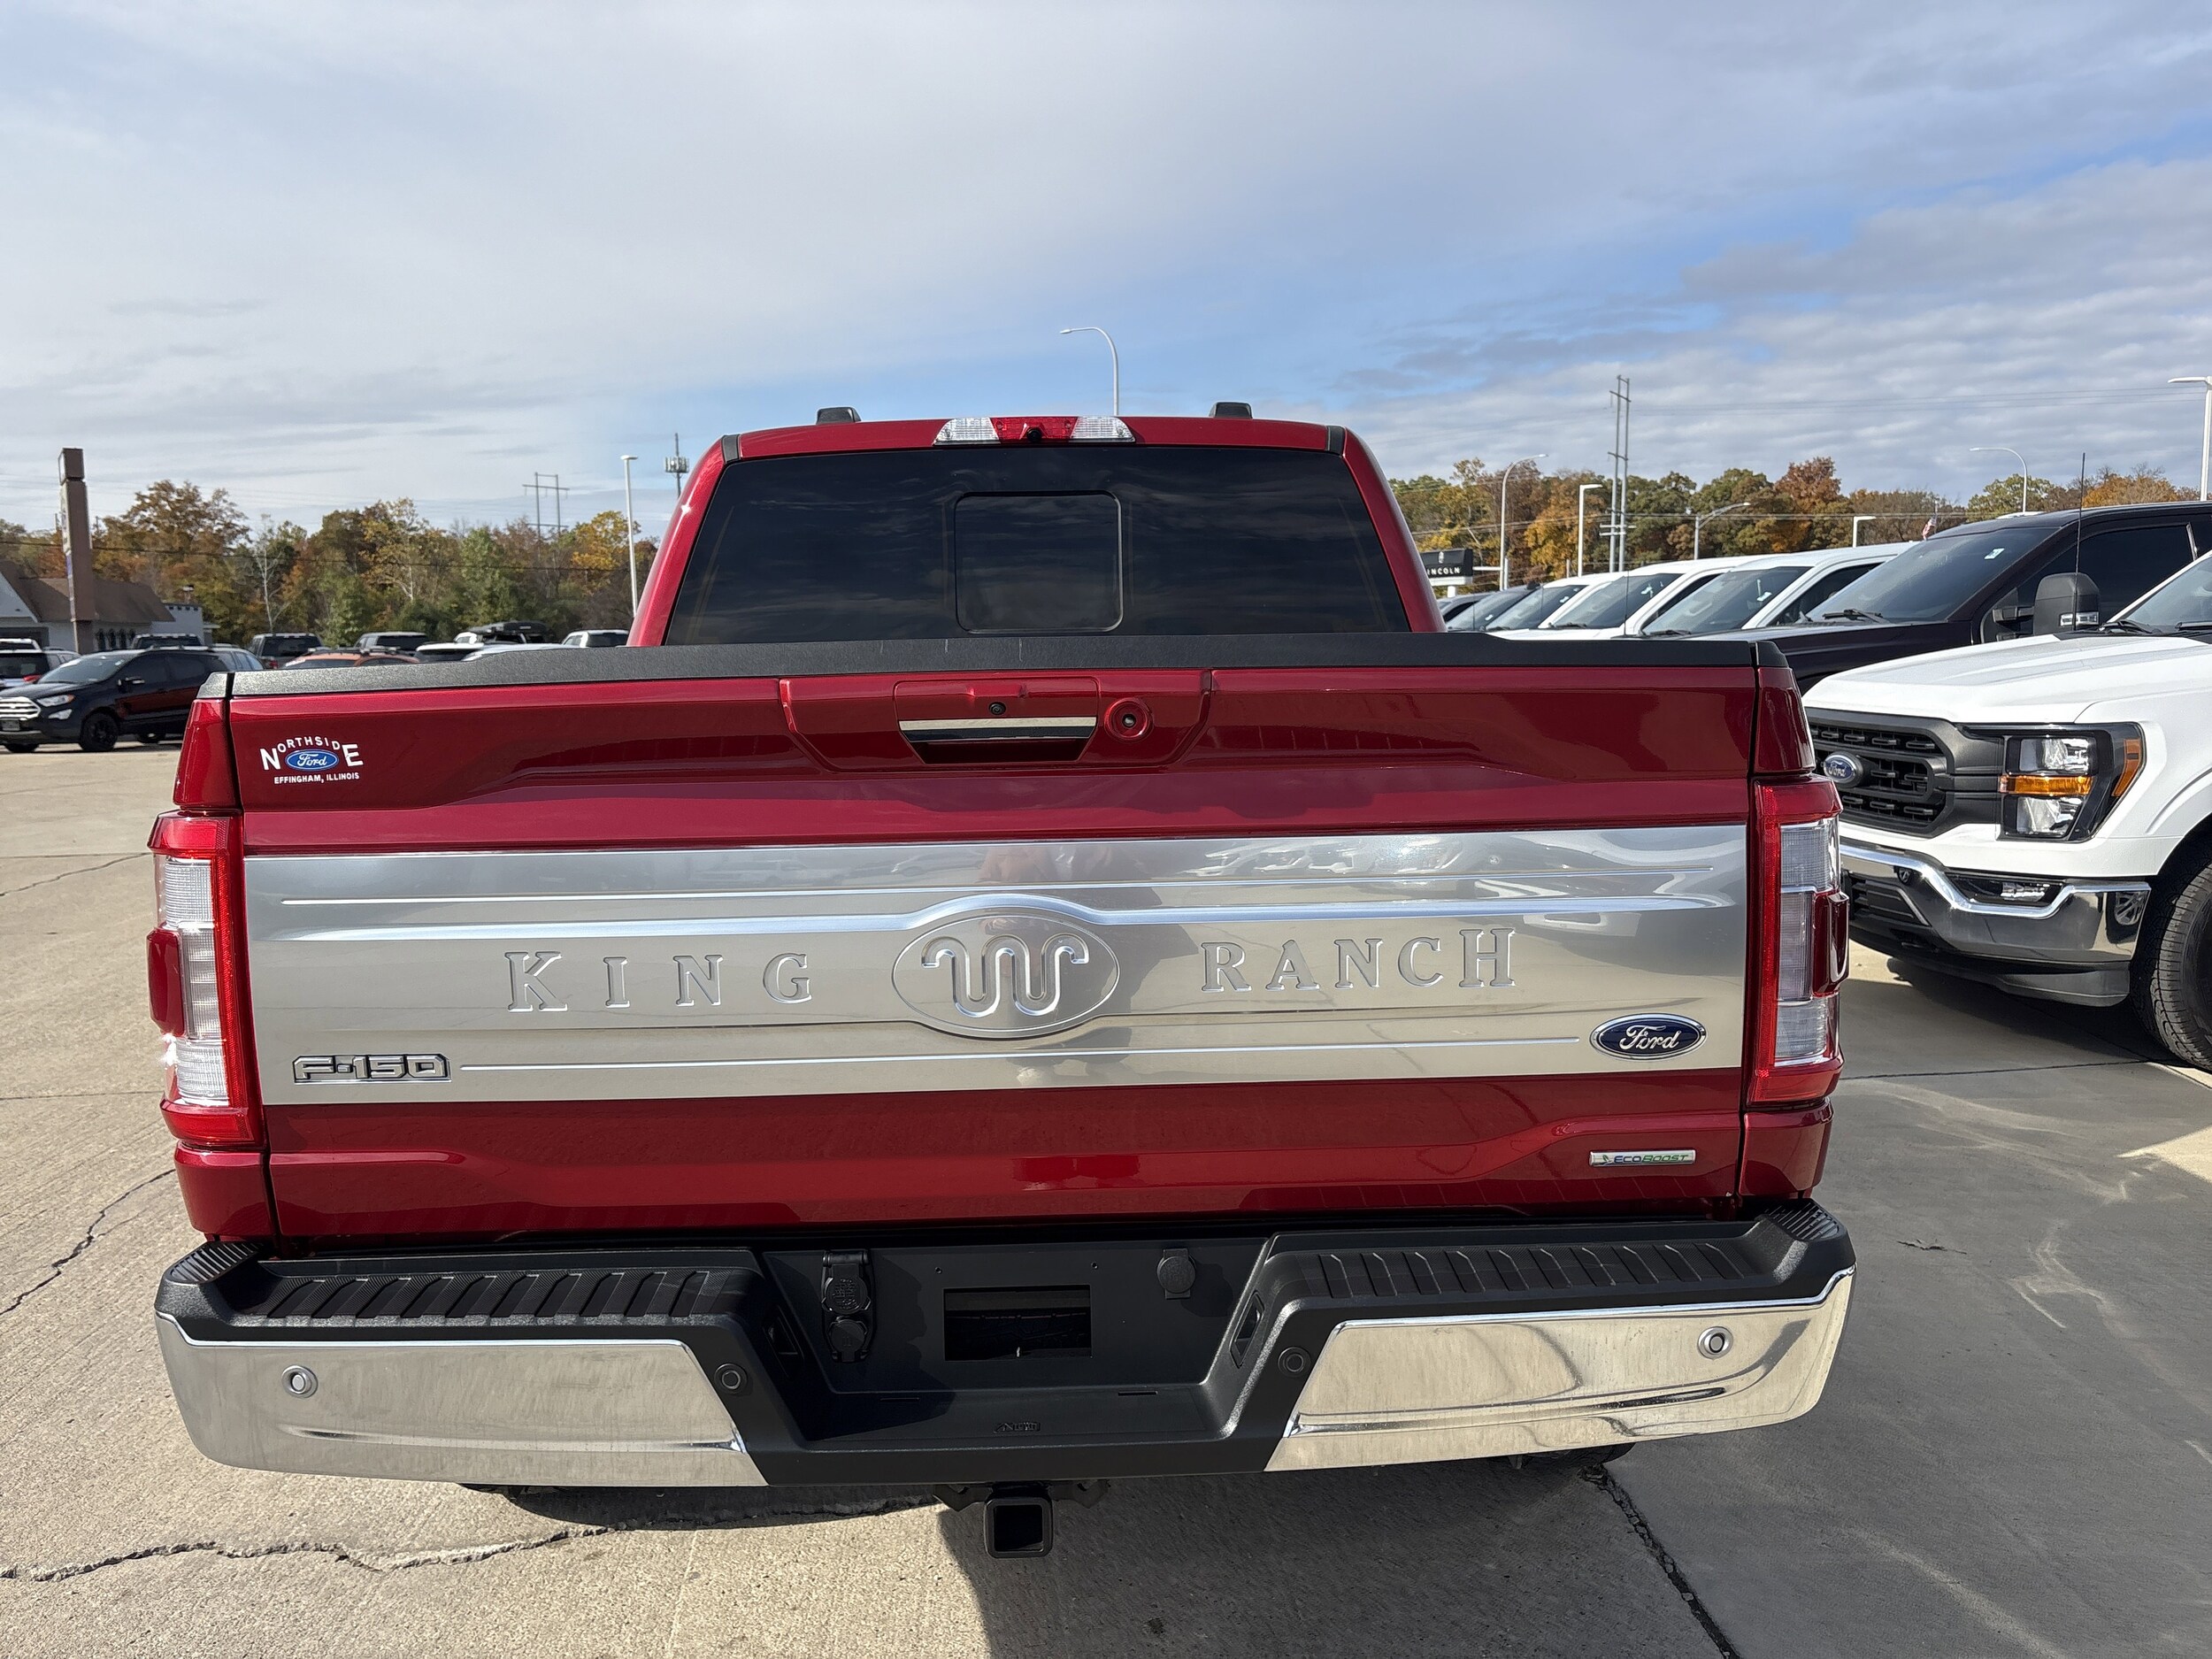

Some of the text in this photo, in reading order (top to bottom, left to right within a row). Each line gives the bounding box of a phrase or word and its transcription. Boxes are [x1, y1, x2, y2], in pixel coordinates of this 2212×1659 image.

[1425, 566, 1461, 576] INCOLN
[259, 736, 364, 771] NORTHSIDE
[296, 753, 327, 766] Ford
[273, 772, 360, 785] EFFINGHAM, ILLINOIS
[1828, 760, 1847, 777] Ford
[503, 927, 1517, 1012] KING RANCH
[1618, 1025, 1682, 1050] Ford
[292, 1054, 449, 1081] F-150
